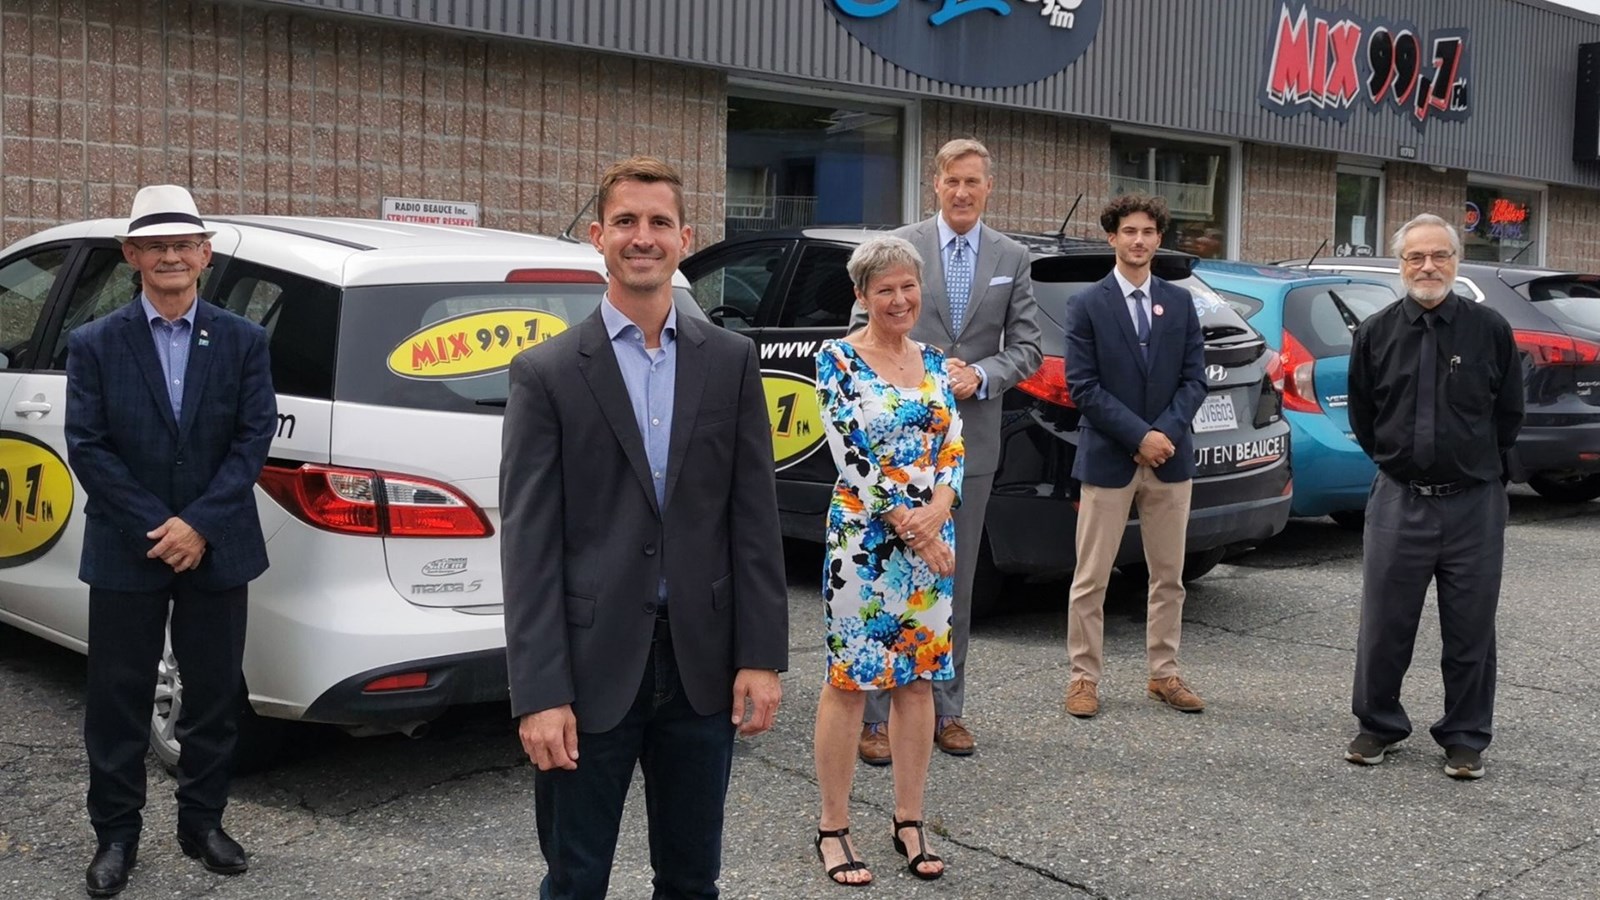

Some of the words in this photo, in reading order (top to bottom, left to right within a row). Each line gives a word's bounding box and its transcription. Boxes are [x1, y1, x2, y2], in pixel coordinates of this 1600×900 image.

[1266, 2, 1362, 109] MIX
[395, 202, 421, 212] RADIO
[423, 204, 452, 214] BEAUCE
[386, 214, 440, 224] STRICTEMENT
[412, 332, 474, 370] MIX
[1213, 445, 1233, 464] EN
